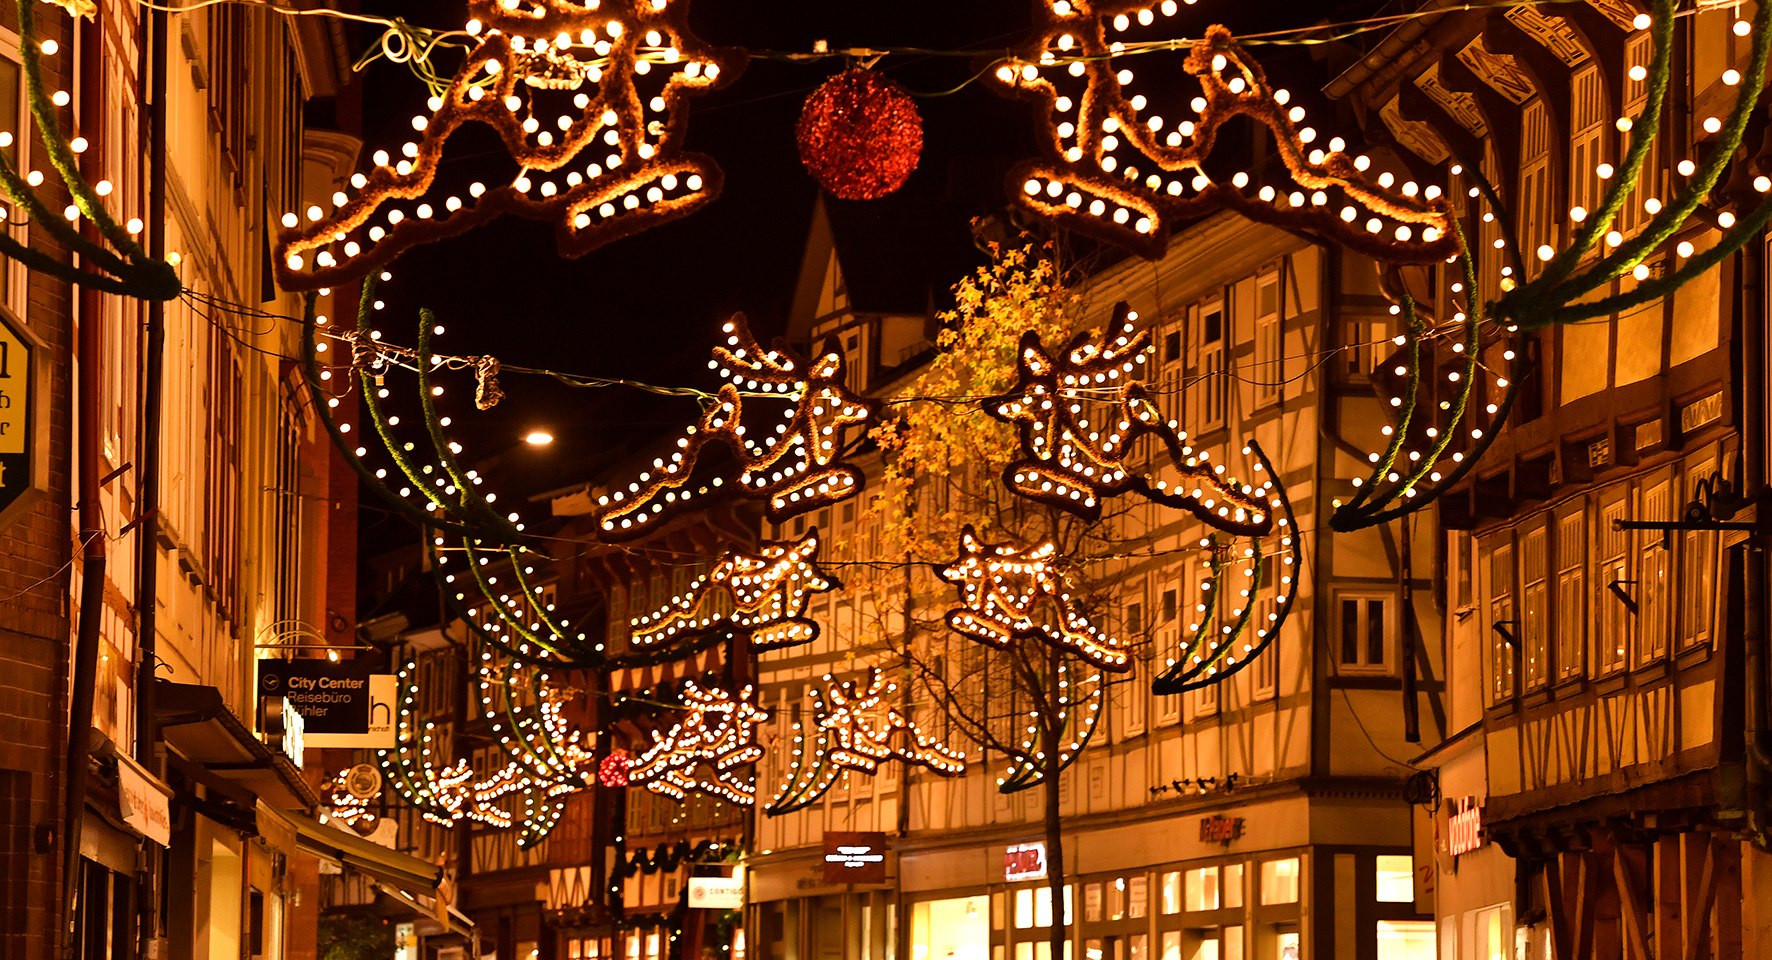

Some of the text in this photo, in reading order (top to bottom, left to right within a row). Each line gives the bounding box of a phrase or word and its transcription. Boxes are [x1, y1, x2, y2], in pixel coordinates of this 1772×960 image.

[287, 676, 365, 691] City Center
[287, 690, 352, 704] Reisebüro
[292, 704, 329, 717] ühler
